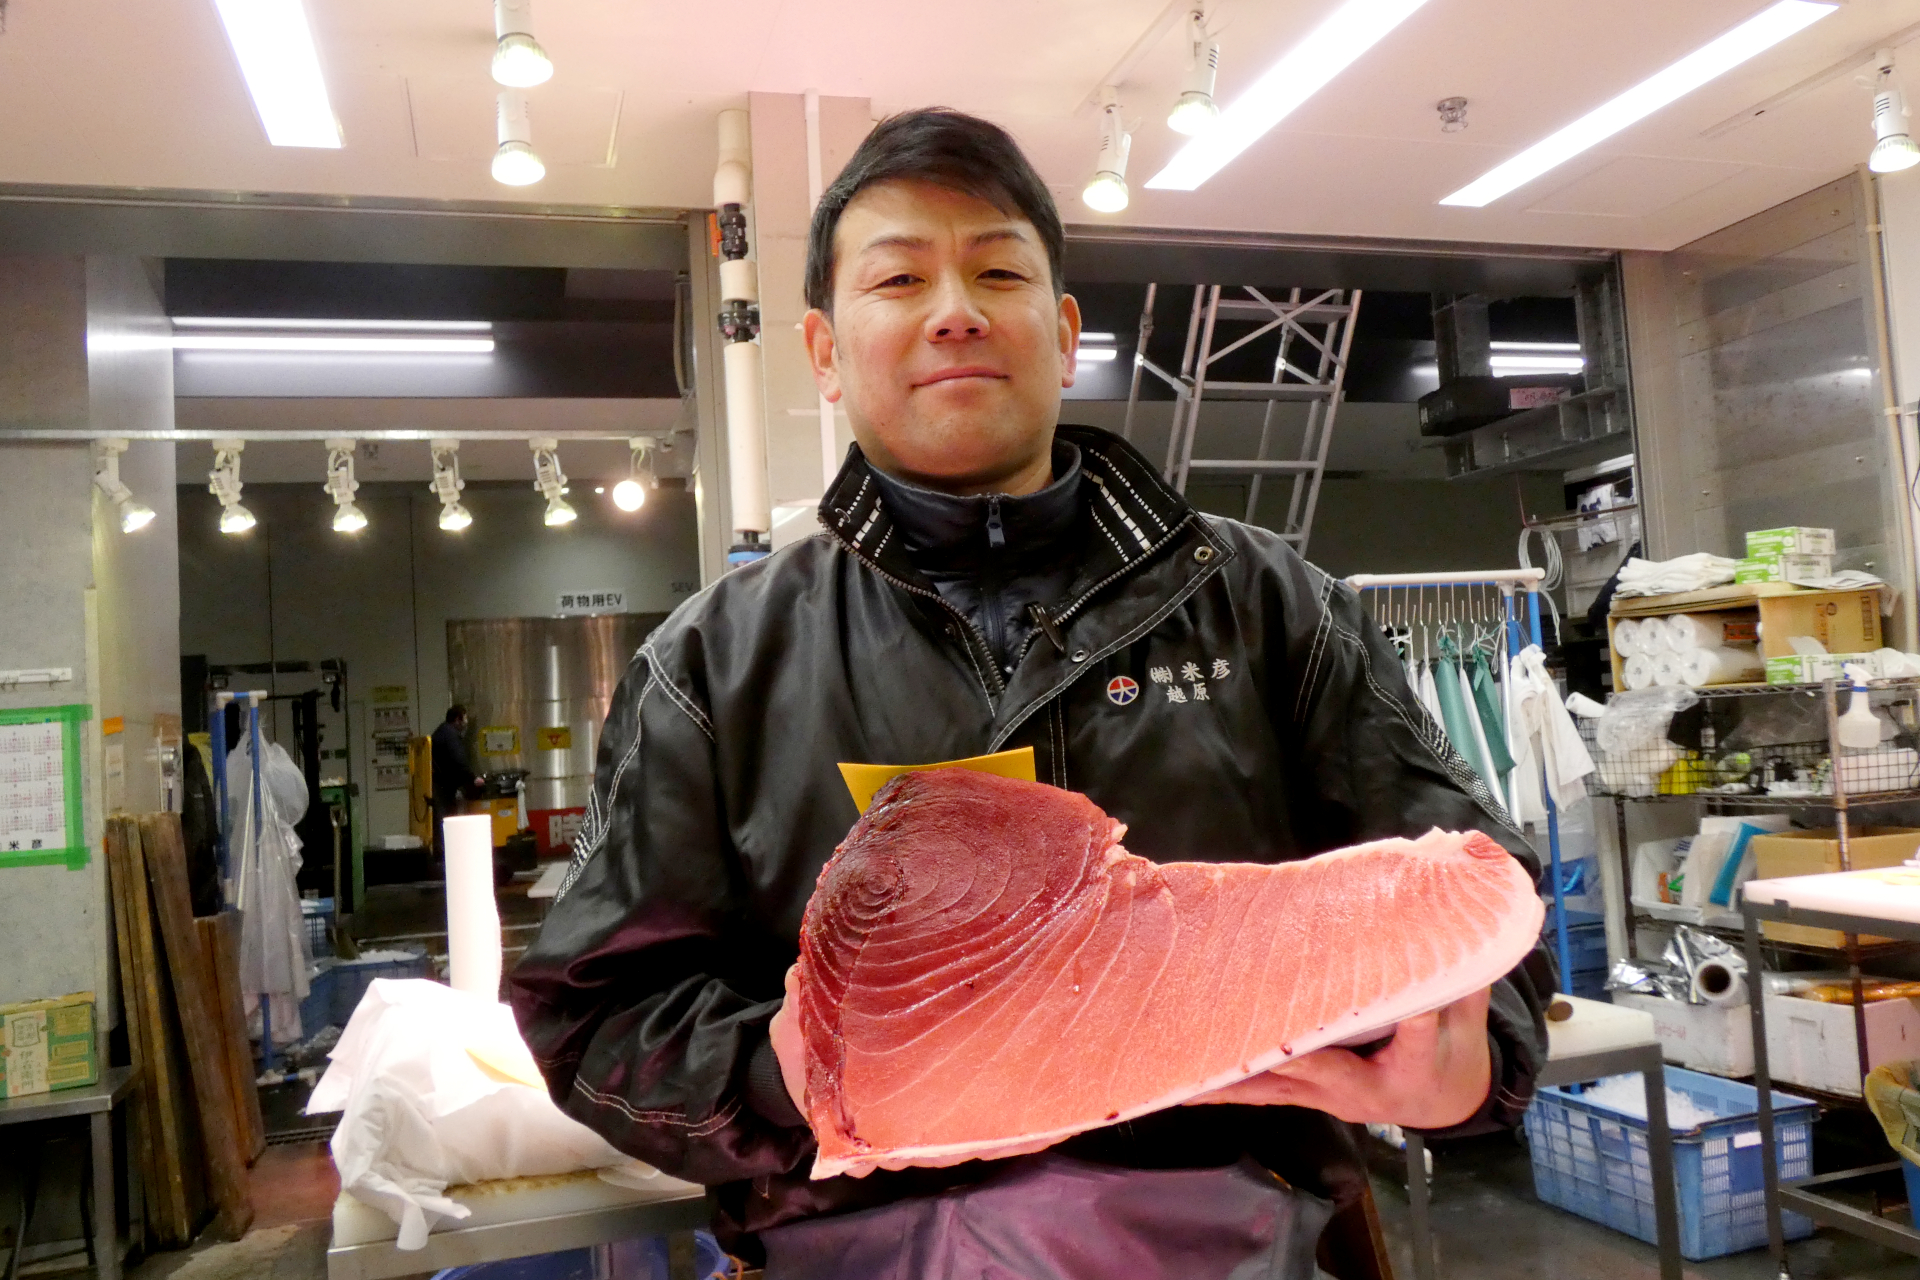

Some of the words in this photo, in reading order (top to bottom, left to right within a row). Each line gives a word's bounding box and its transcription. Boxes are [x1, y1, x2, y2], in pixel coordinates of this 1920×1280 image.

[561, 593, 623, 609] 荷物用EV
[1166, 682, 1210, 704] 越原
